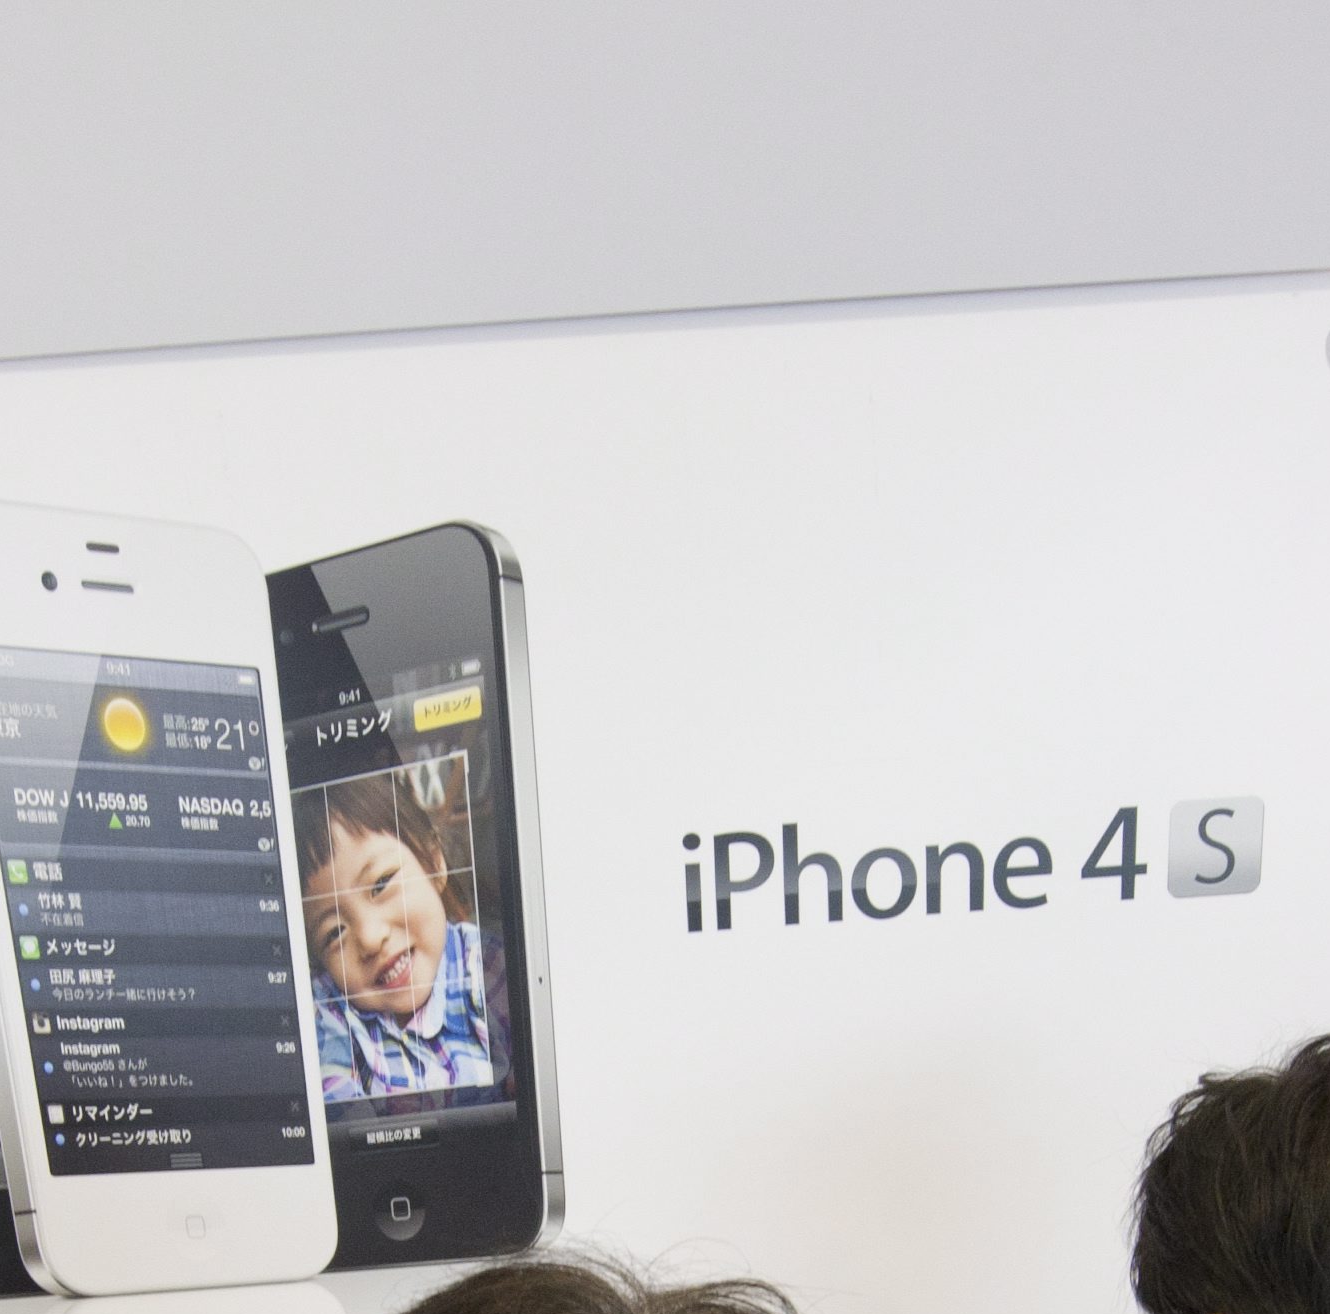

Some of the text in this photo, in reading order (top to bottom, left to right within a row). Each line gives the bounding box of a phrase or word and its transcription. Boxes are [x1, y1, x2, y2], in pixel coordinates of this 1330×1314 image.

[106, 662, 131, 676] 9:41
[339, 688, 361, 705] 9:41
[424, 695, 472, 718] トリミング
[316, 708, 393, 746] トリミング
[13, 788, 55, 806] DOW
[75, 791, 148, 812] 11,559.95
[178, 796, 245, 817] NASDAQ
[17, 810, 59, 825] 株価指数
[125, 816, 151, 828] 20.70
[180, 817, 219, 831] 株価指数
[33, 861, 63, 882] 電話
[682, 822, 1054, 933] iPhone
[259, 900, 280, 913] 9:36
[46, 938, 116, 956] メッセージ
[268, 972, 287, 984] 9:27
[56, 1015, 125, 1032] Instagram
[61, 1042, 121, 1056] Instagram
[276, 1042, 296, 1054] 9:26
[118, 1059, 148, 1071] さんが
[72, 1103, 153, 1121] リマインダー
[75, 1128, 191, 1147] クリーニング受け取り
[281, 1126, 306, 1139] 10:00
